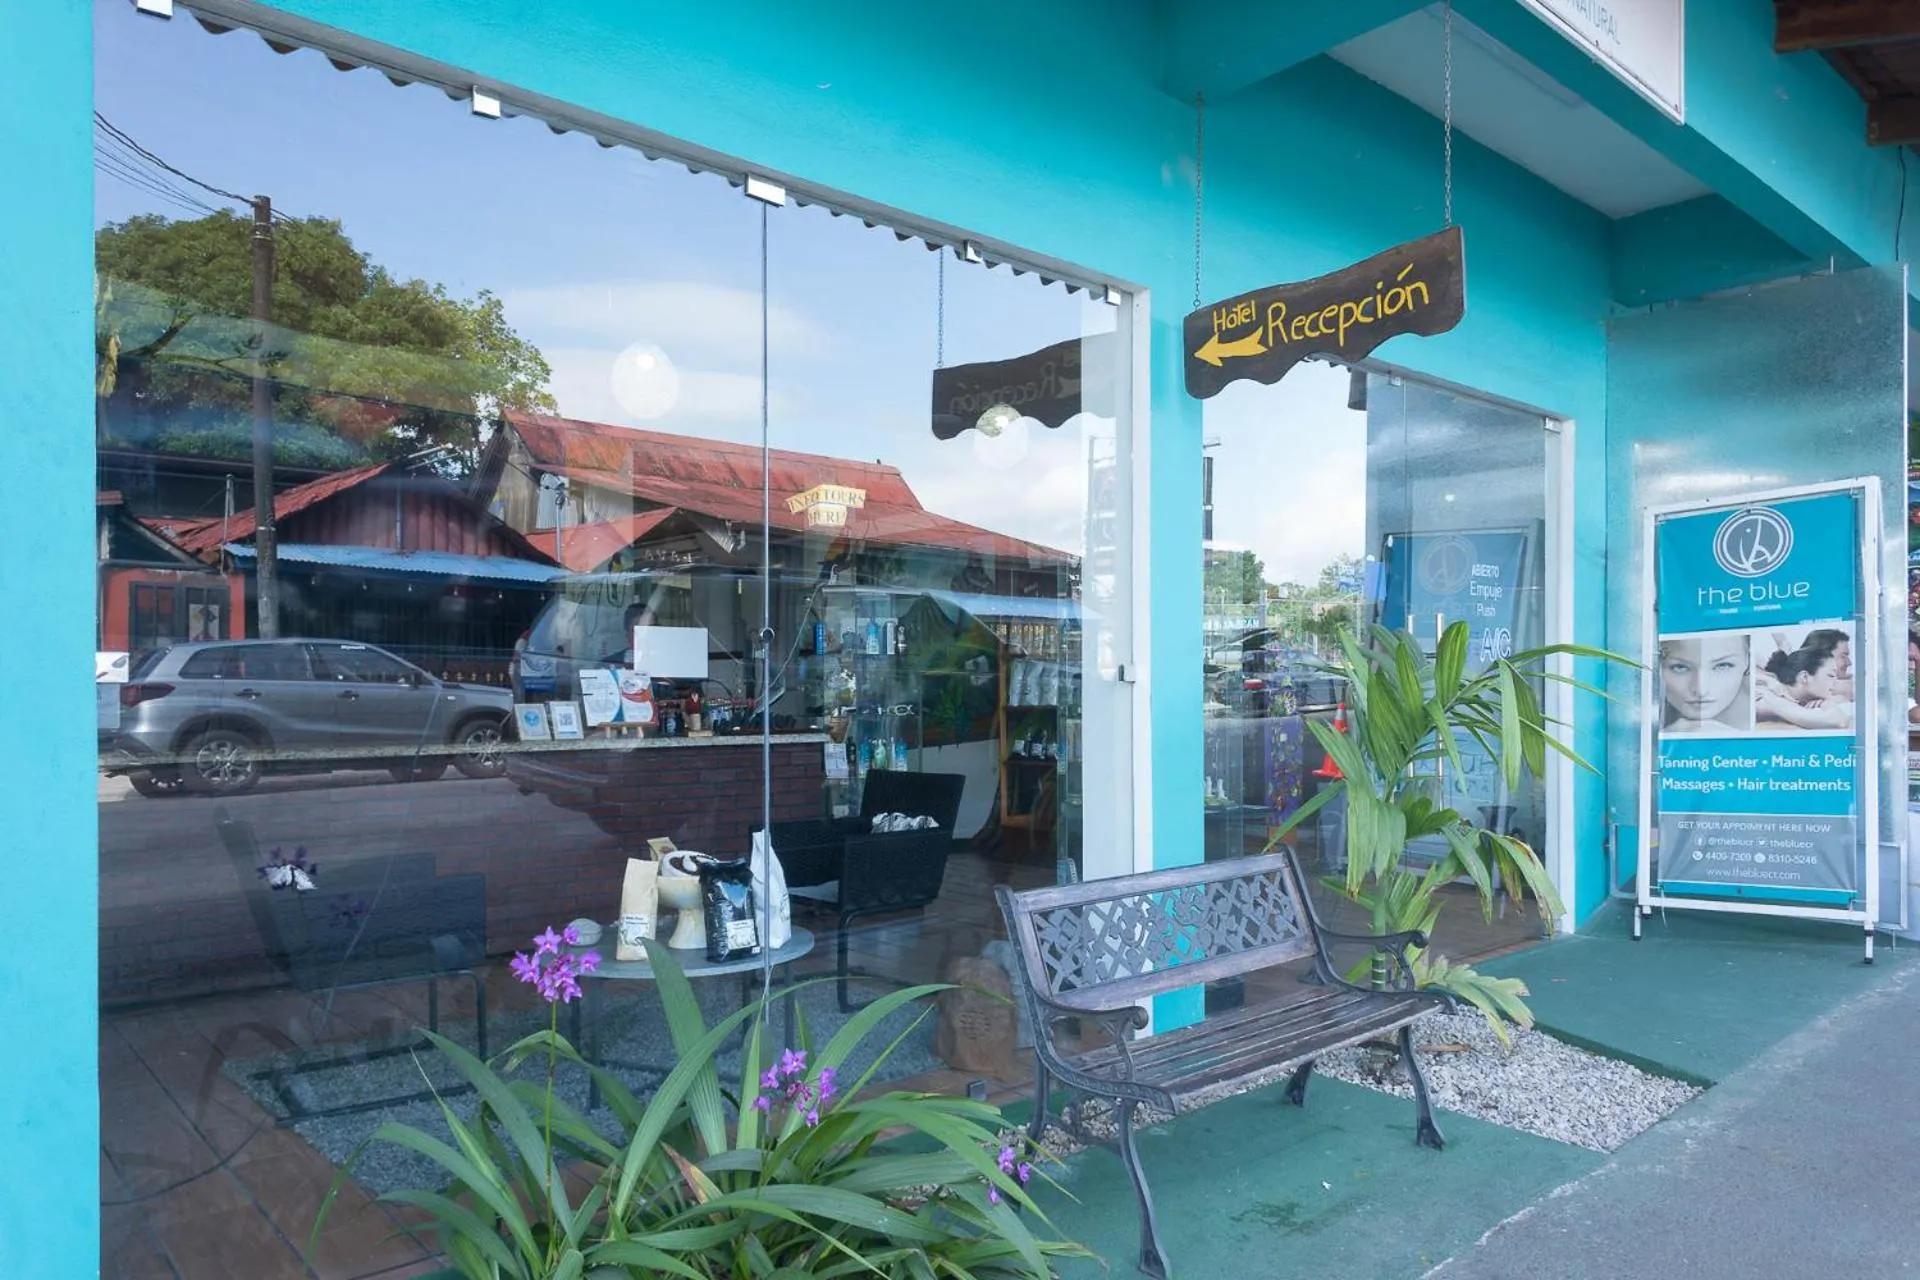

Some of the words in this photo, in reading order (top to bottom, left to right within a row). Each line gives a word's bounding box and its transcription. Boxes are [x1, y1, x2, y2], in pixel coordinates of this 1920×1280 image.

[1213, 300, 1256, 333] Hotel
[1267, 263, 1429, 347] Recepción
[1470, 581, 1503, 601] Empuje
[1698, 587, 1743, 605] the
[1750, 581, 1810, 601] blue
[1480, 627, 1512, 662] A/C
[1657, 755, 1710, 772] Tanning
[1712, 755, 1759, 768] Center
[1771, 755, 1805, 768] Mani
[1808, 754, 1820, 768] &
[1824, 754, 1857, 768] Pedi
[1662, 778, 1725, 793] Massages
[1738, 778, 1766, 791] Hair
[1769, 778, 1851, 791] treatments
[1677, 821, 1694, 830] GET
[1696, 821, 1721, 831] YOUR
[1779, 823, 1802, 832] HERE
[1805, 824, 1832, 833] NOW
